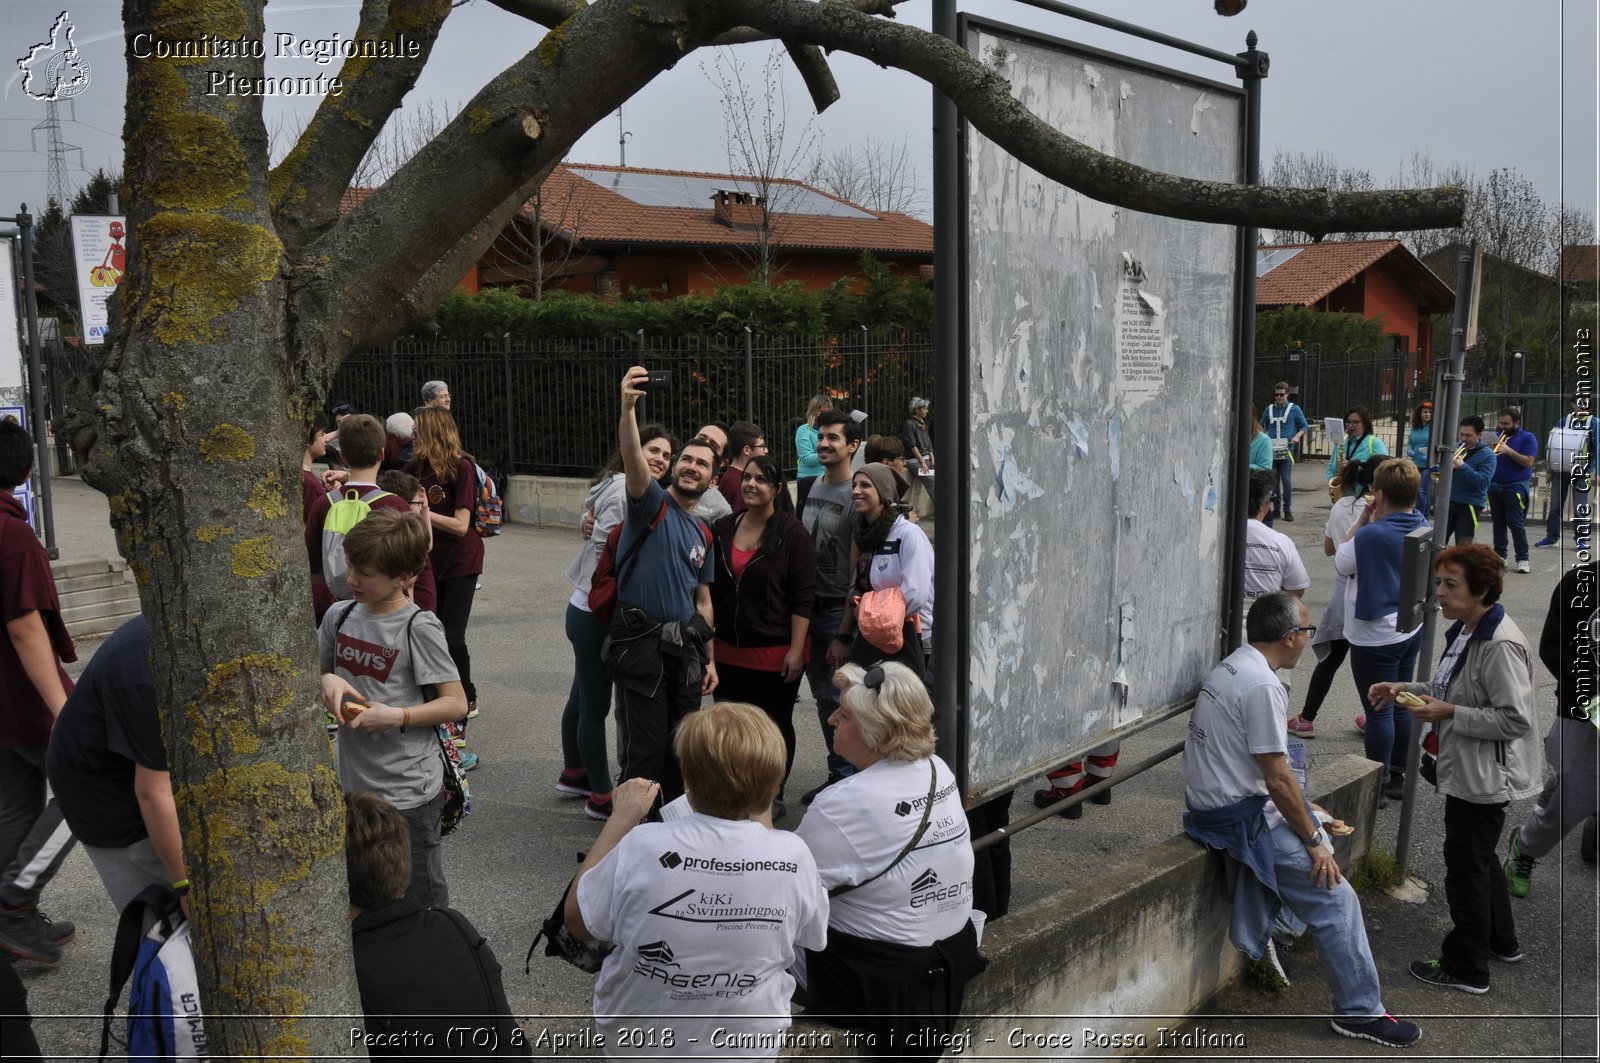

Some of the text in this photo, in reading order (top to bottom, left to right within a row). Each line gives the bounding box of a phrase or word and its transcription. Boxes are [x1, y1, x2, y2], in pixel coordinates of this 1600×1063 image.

[683, 856, 799, 874] professionecasa
[687, 902, 788, 919] Swimmingpool
[716, 923, 744, 931] Piscine
